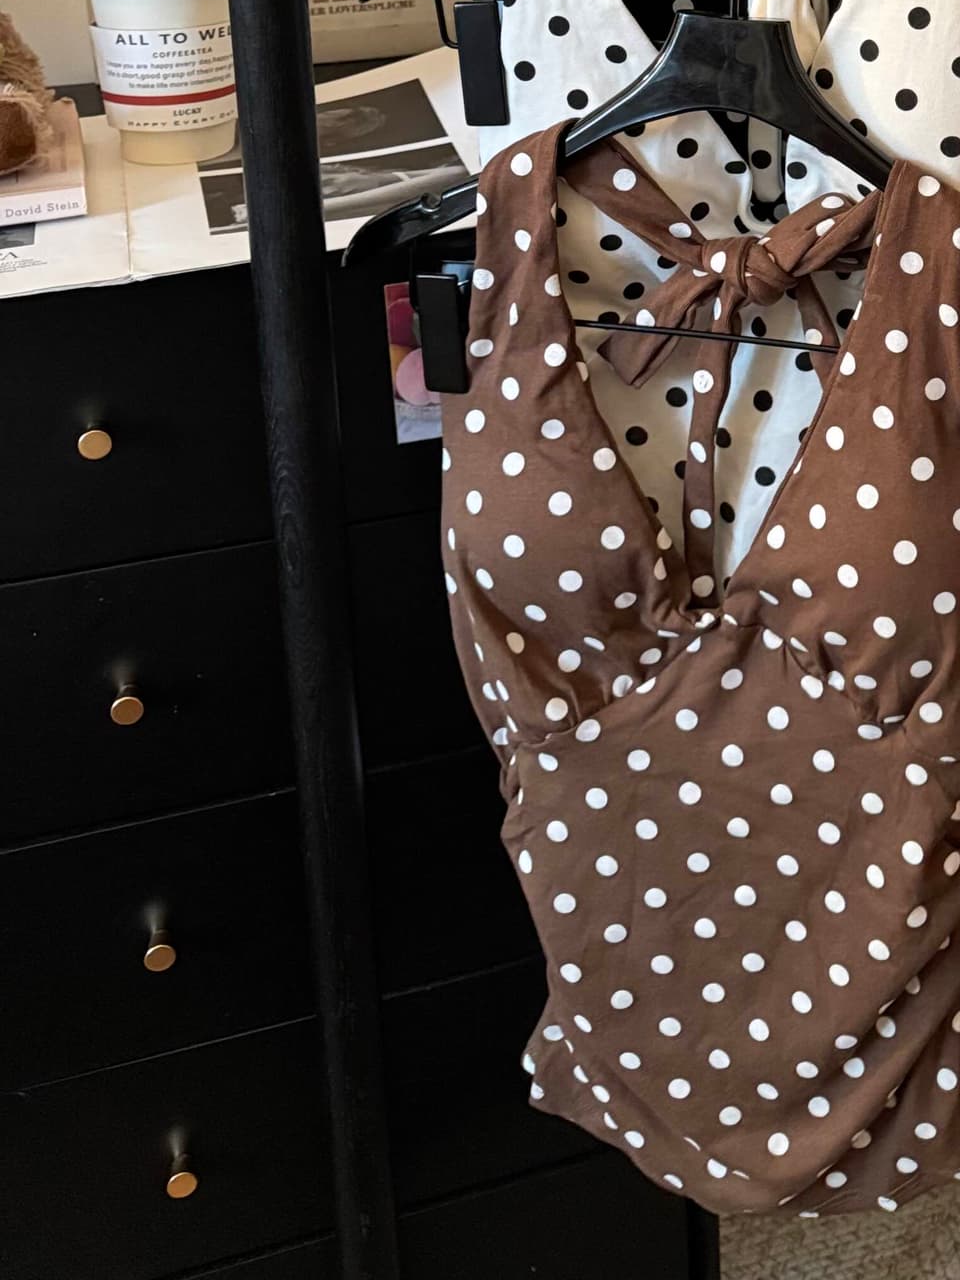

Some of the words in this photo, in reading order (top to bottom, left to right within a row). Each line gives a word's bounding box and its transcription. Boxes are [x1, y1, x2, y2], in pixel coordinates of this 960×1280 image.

[115, 33, 150, 46] ALL
[159, 32, 188, 45] TO
[152, 46, 213, 59] COFFEE&TEA
[150, 63, 173, 71] happy
[175, 60, 197, 69] every
[169, 81, 189, 89] more
[5, 204, 42, 218] David
[47, 200, 80, 213] Stein
